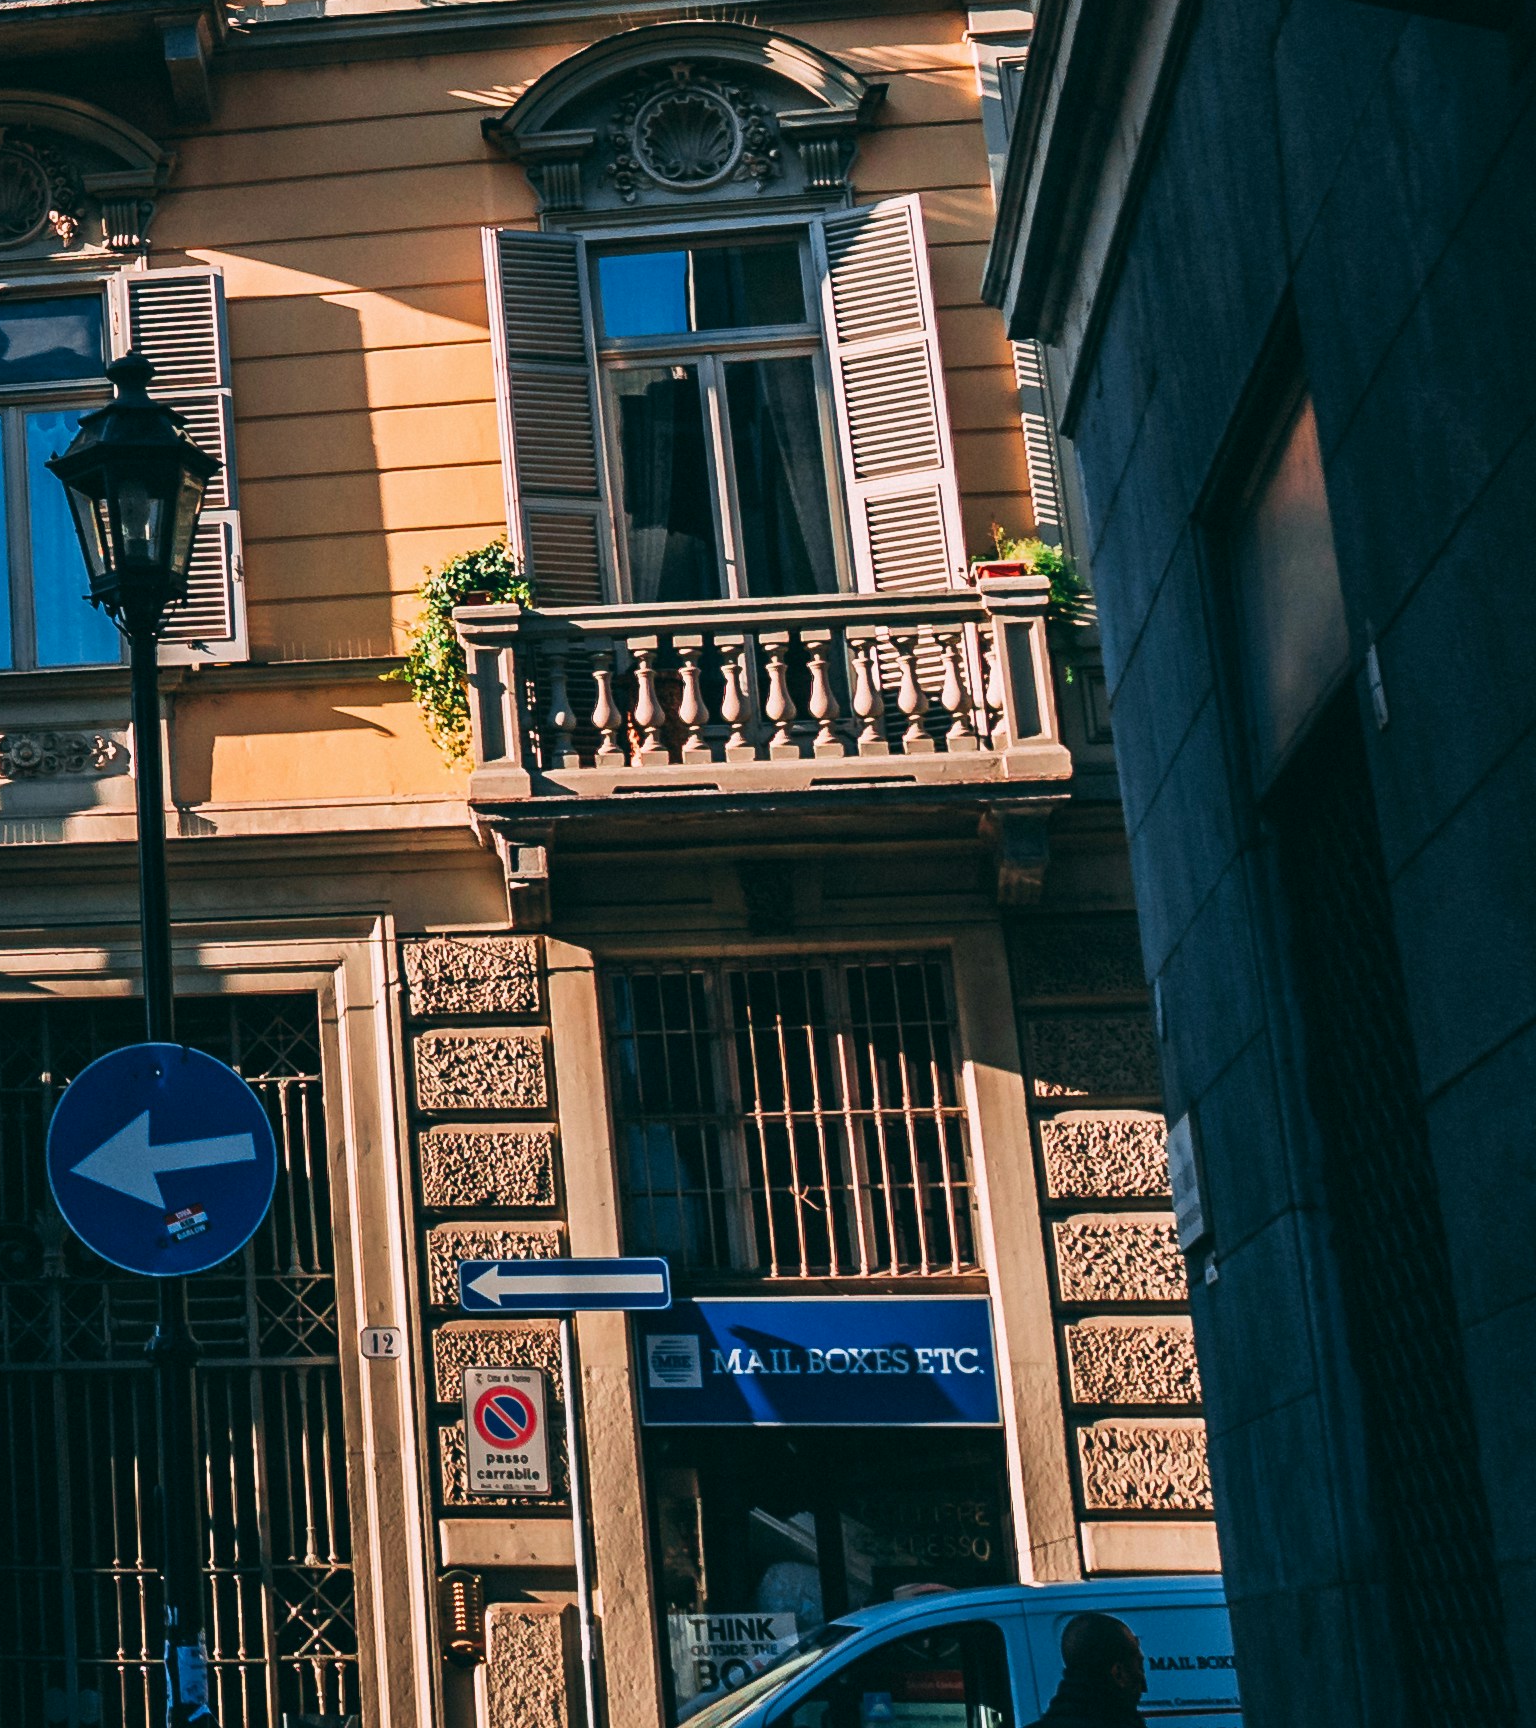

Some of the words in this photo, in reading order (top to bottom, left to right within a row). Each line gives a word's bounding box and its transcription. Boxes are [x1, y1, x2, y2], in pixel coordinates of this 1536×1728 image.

[372, 1332, 394, 1354] 12
[712, 1348, 801, 1375] MAIL
[806, 1347, 909, 1375] BOXES
[914, 1347, 985, 1375] ETC.
[486, 1453, 529, 1466] passo
[476, 1467, 540, 1481] carrabile
[688, 1617, 777, 1642] THINK
[690, 1643, 749, 1657] OUTSIDE
[751, 1642, 778, 1655] THE
[1148, 1655, 1196, 1670] MAIL
[692, 1658, 765, 1694] BO
